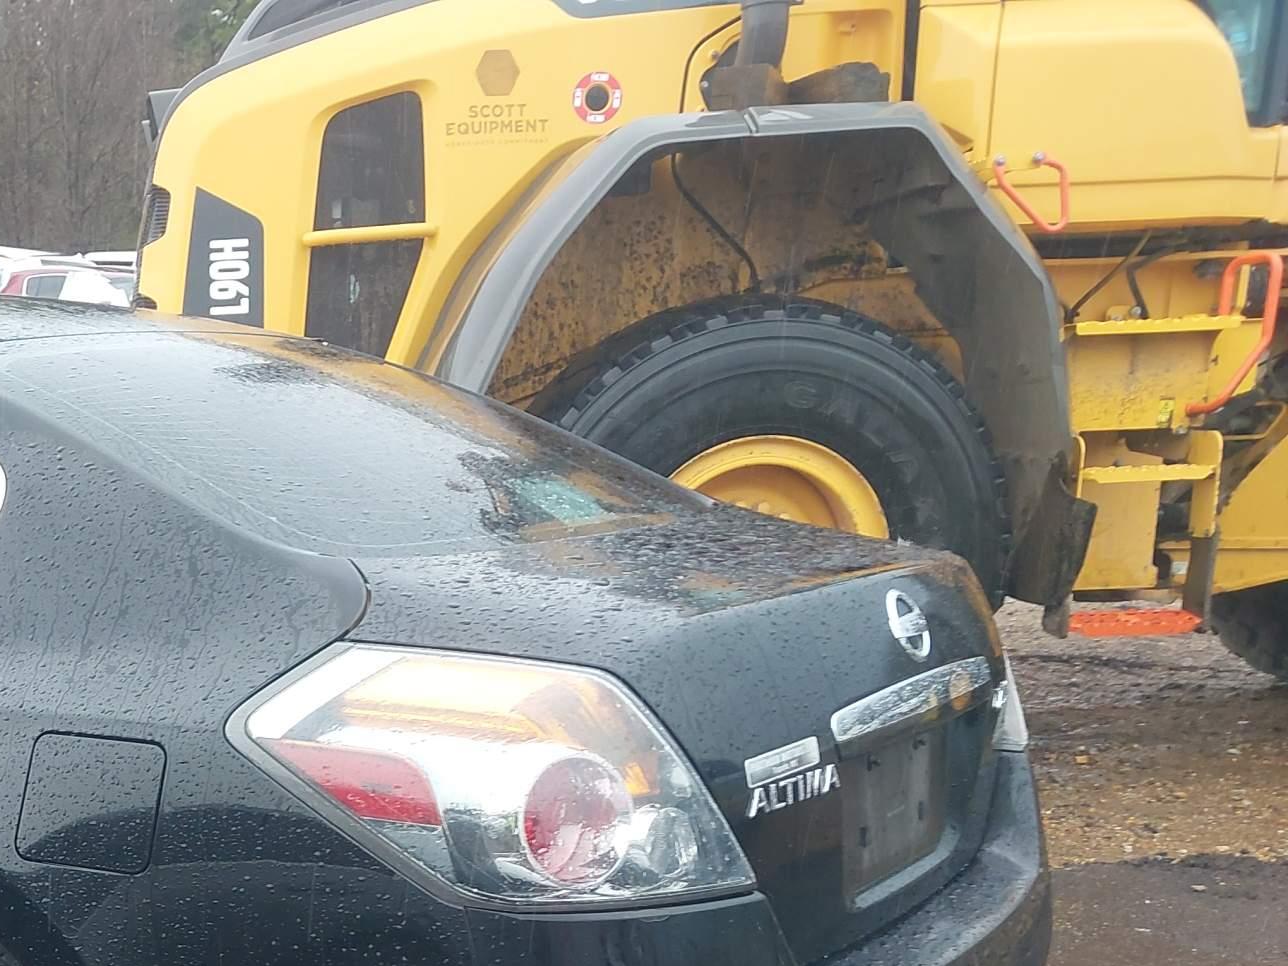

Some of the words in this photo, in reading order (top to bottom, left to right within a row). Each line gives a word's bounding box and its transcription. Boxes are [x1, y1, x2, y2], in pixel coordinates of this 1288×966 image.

[445, 119, 549, 136] EQUIPMENT
[468, 103, 527, 118] SCOTT
[209, 238, 250, 315] L90H
[746, 763, 841, 818] ALTIMA
